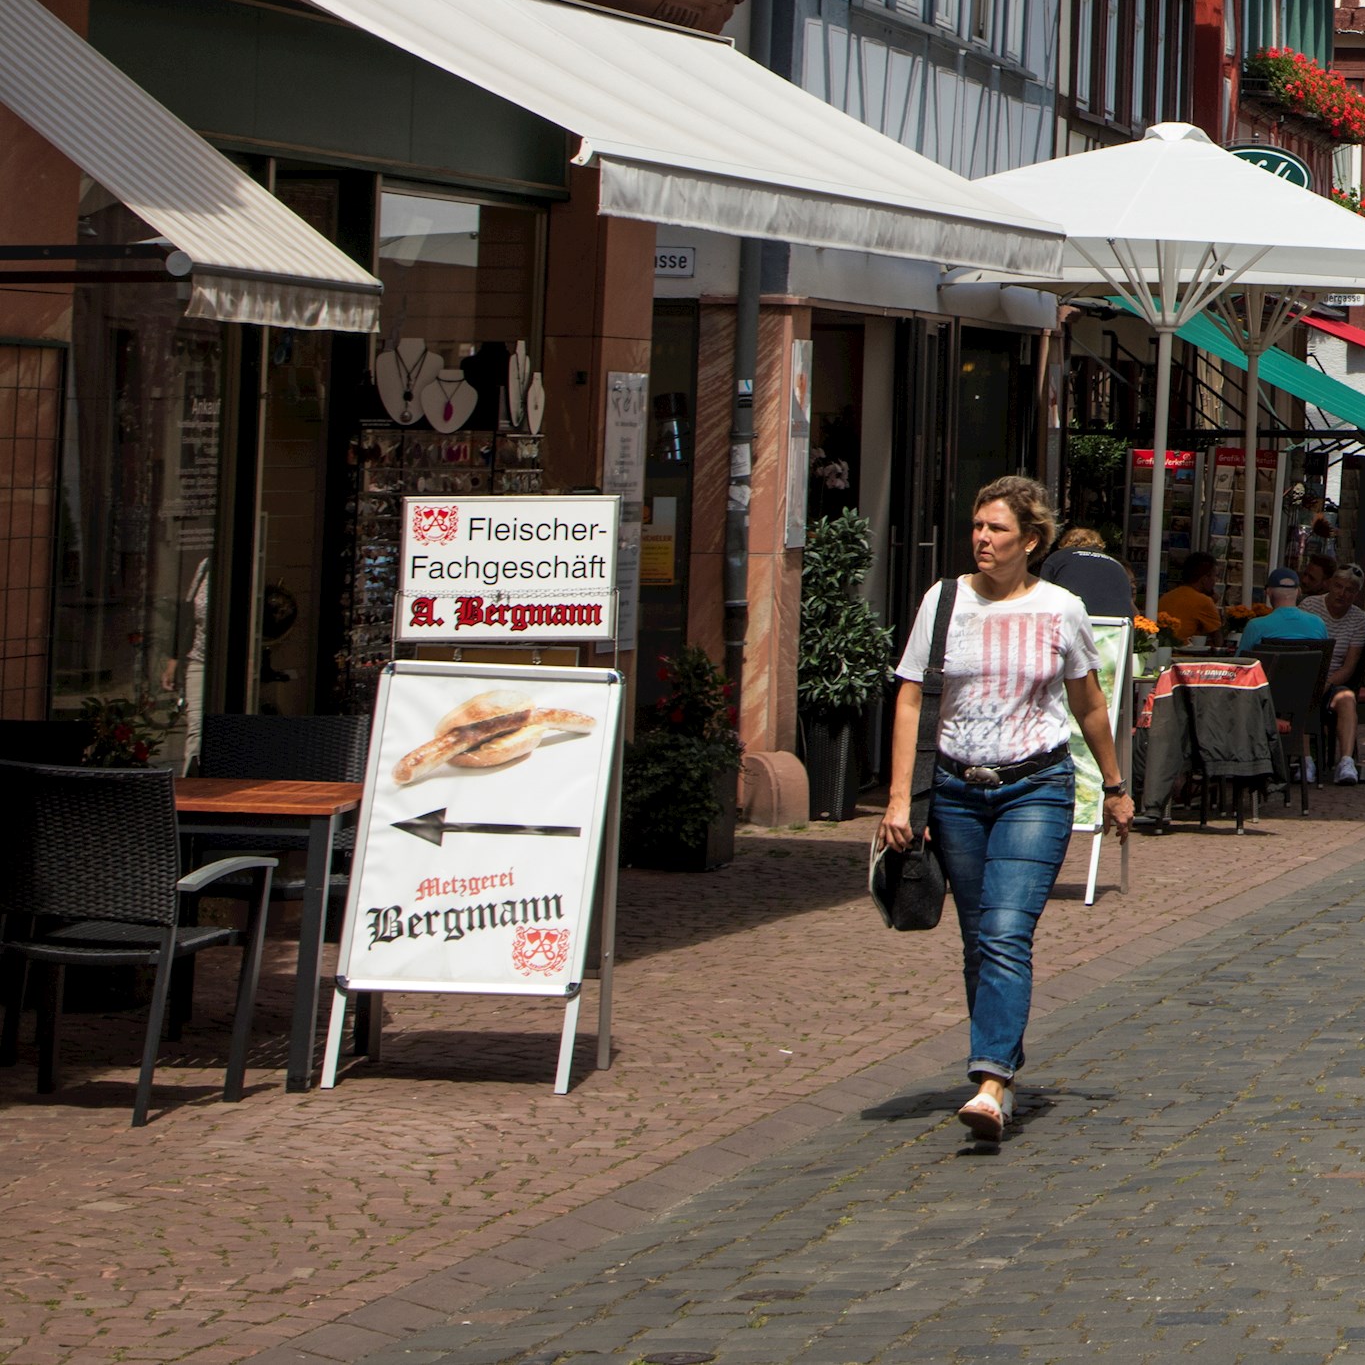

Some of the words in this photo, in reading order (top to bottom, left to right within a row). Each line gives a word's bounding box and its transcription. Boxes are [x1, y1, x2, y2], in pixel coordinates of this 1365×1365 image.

[191, 397, 222, 415] Ankauf
[468, 517, 607, 541] Fleischer-
[410, 555, 606, 585] Fachgeschäft
[409, 596, 445, 627] A.
[454, 595, 603, 632] Bergmann
[414, 866, 515, 902] Metzgerei
[365, 893, 565, 951] Bergmann
